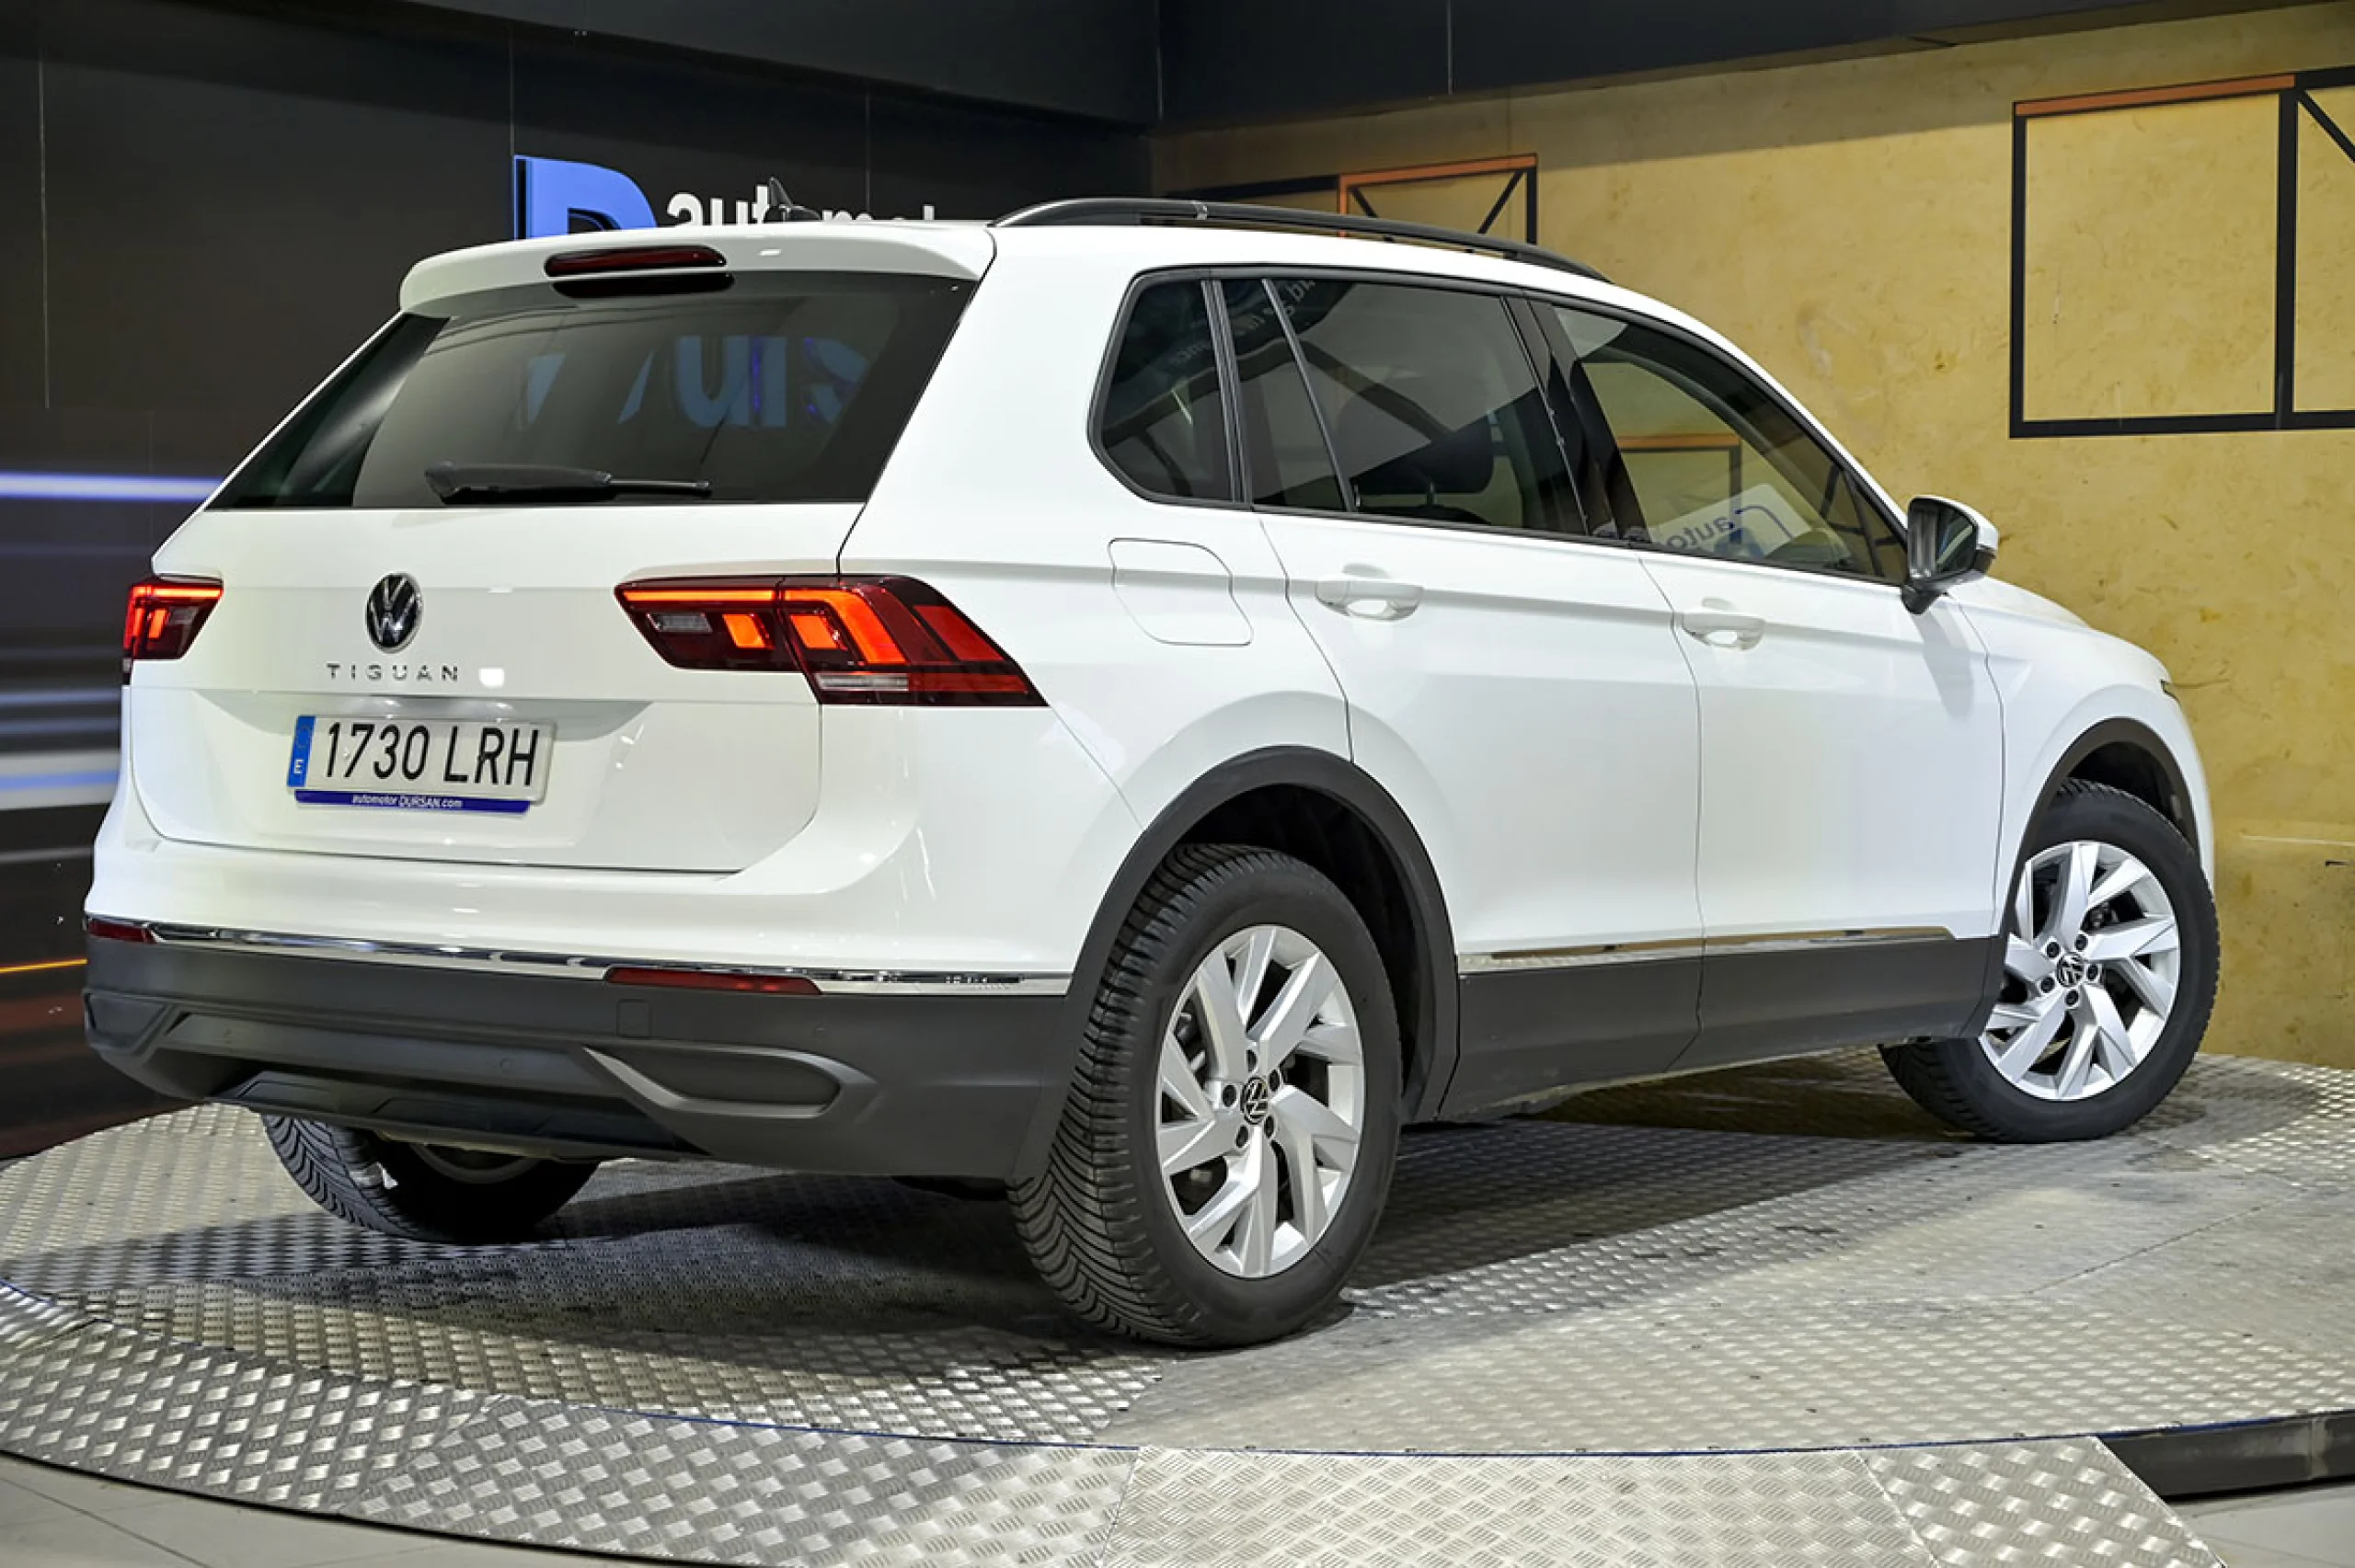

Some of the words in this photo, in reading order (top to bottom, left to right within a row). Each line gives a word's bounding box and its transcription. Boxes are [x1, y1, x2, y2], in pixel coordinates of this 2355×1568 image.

[327, 662, 459, 682] TIGUAN
[293, 758, 304, 774] E
[326, 721, 431, 781] 1730
[442, 725, 540, 786] LRH
